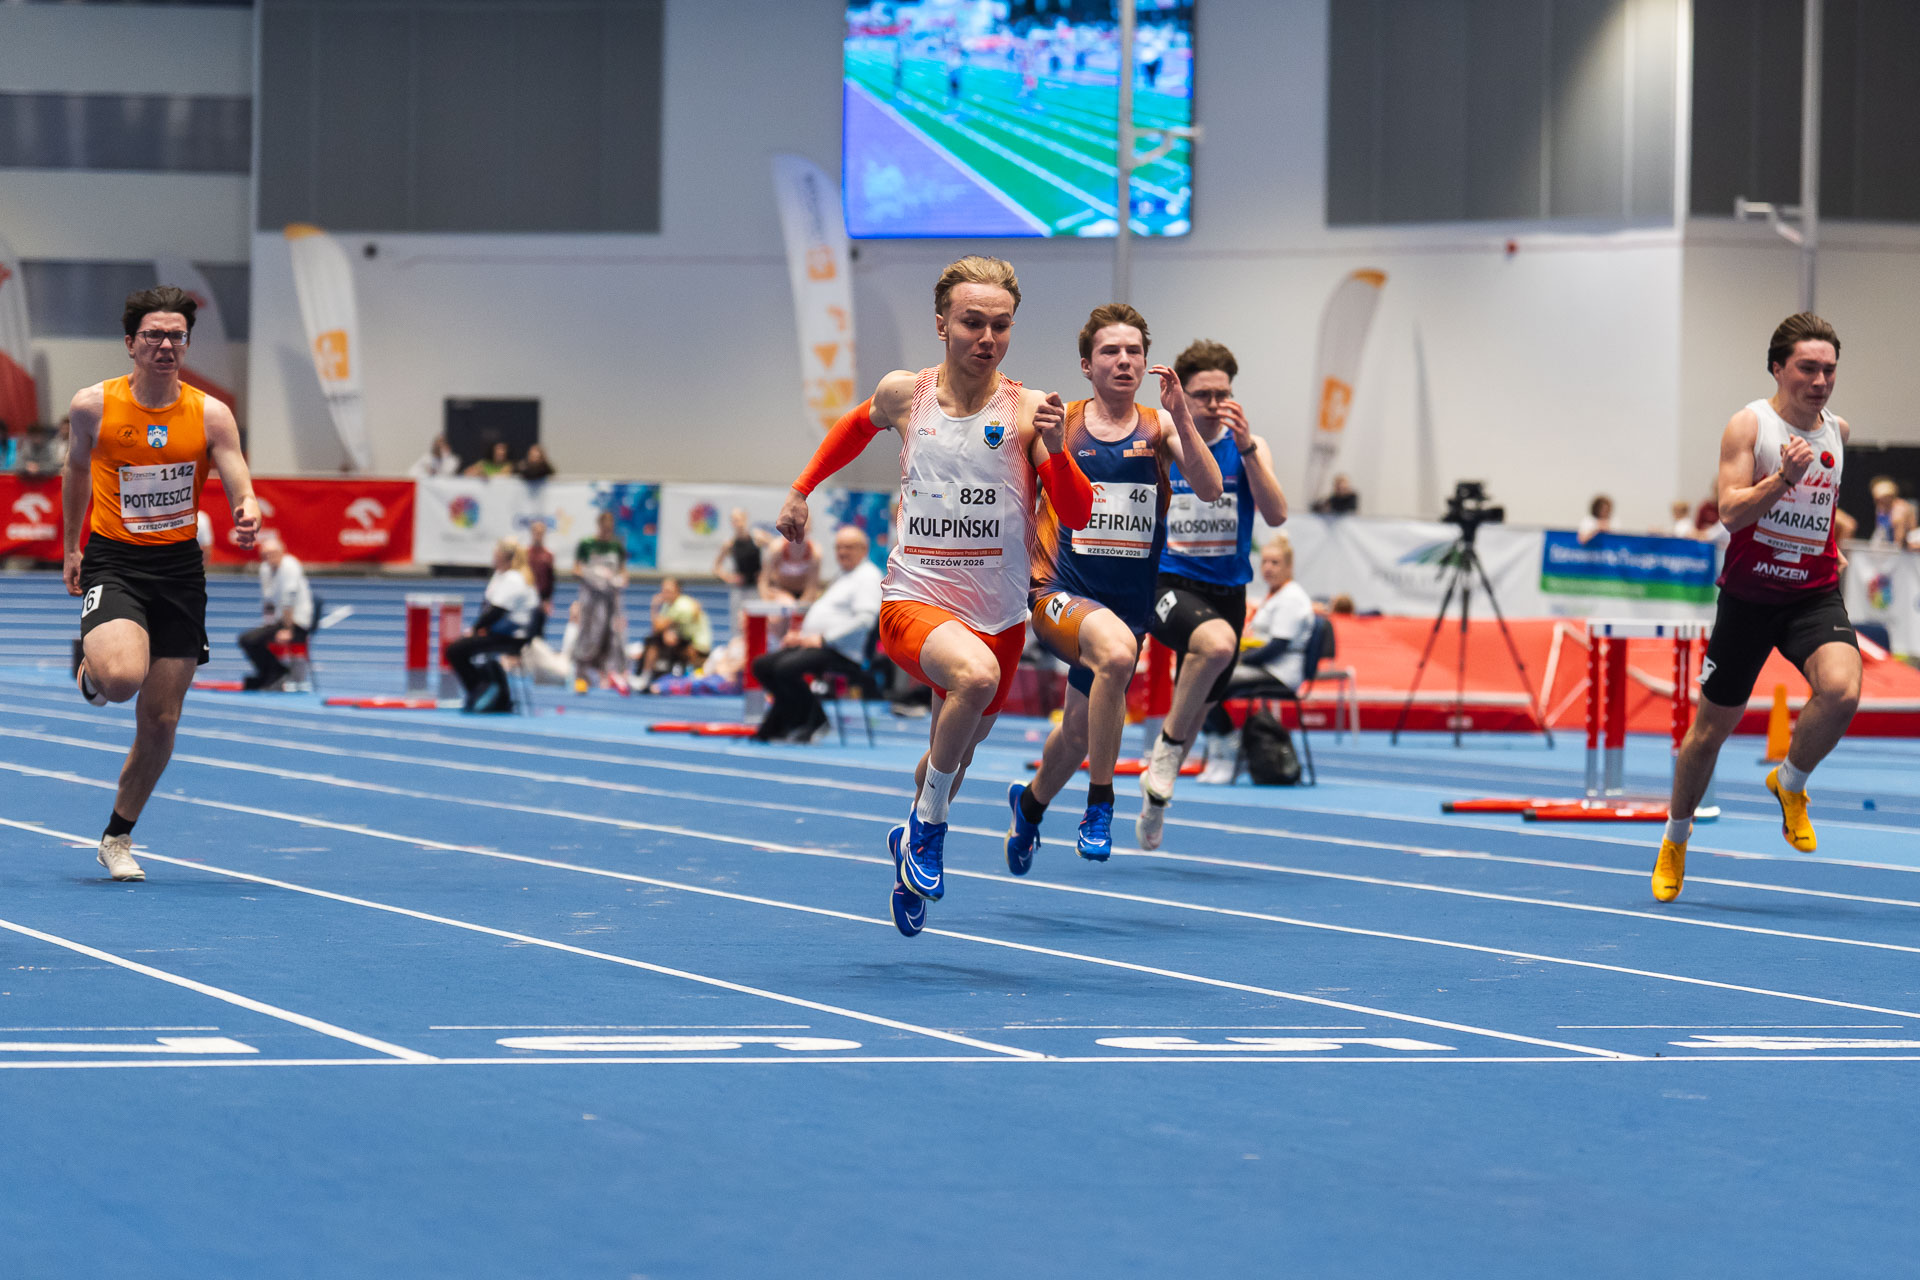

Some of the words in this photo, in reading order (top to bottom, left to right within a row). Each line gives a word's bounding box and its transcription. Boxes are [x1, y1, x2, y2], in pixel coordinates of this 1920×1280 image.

[160, 465, 194, 481] 1142
[124, 486, 192, 509] POTRZESZCZ
[960, 488, 996, 505] 828
[1129, 488, 1147, 504] 46
[1810, 491, 1831, 506] 189
[138, 521, 169, 531] RZESZÓW
[909, 515, 1000, 538] KULPIŃSKI
[1085, 513, 1152, 533] EFIRIAN
[1170, 519, 1237, 534] KŁOSOWSKI
[1763, 508, 1830, 532] MARIASZ
[1088, 547, 1124, 555] RZESZÓW
[920, 557, 961, 566] RZESZÓW
[1752, 561, 1809, 580] JANZEN
[86, 590, 96, 612] 6
[1052, 598, 1064, 617] 4
